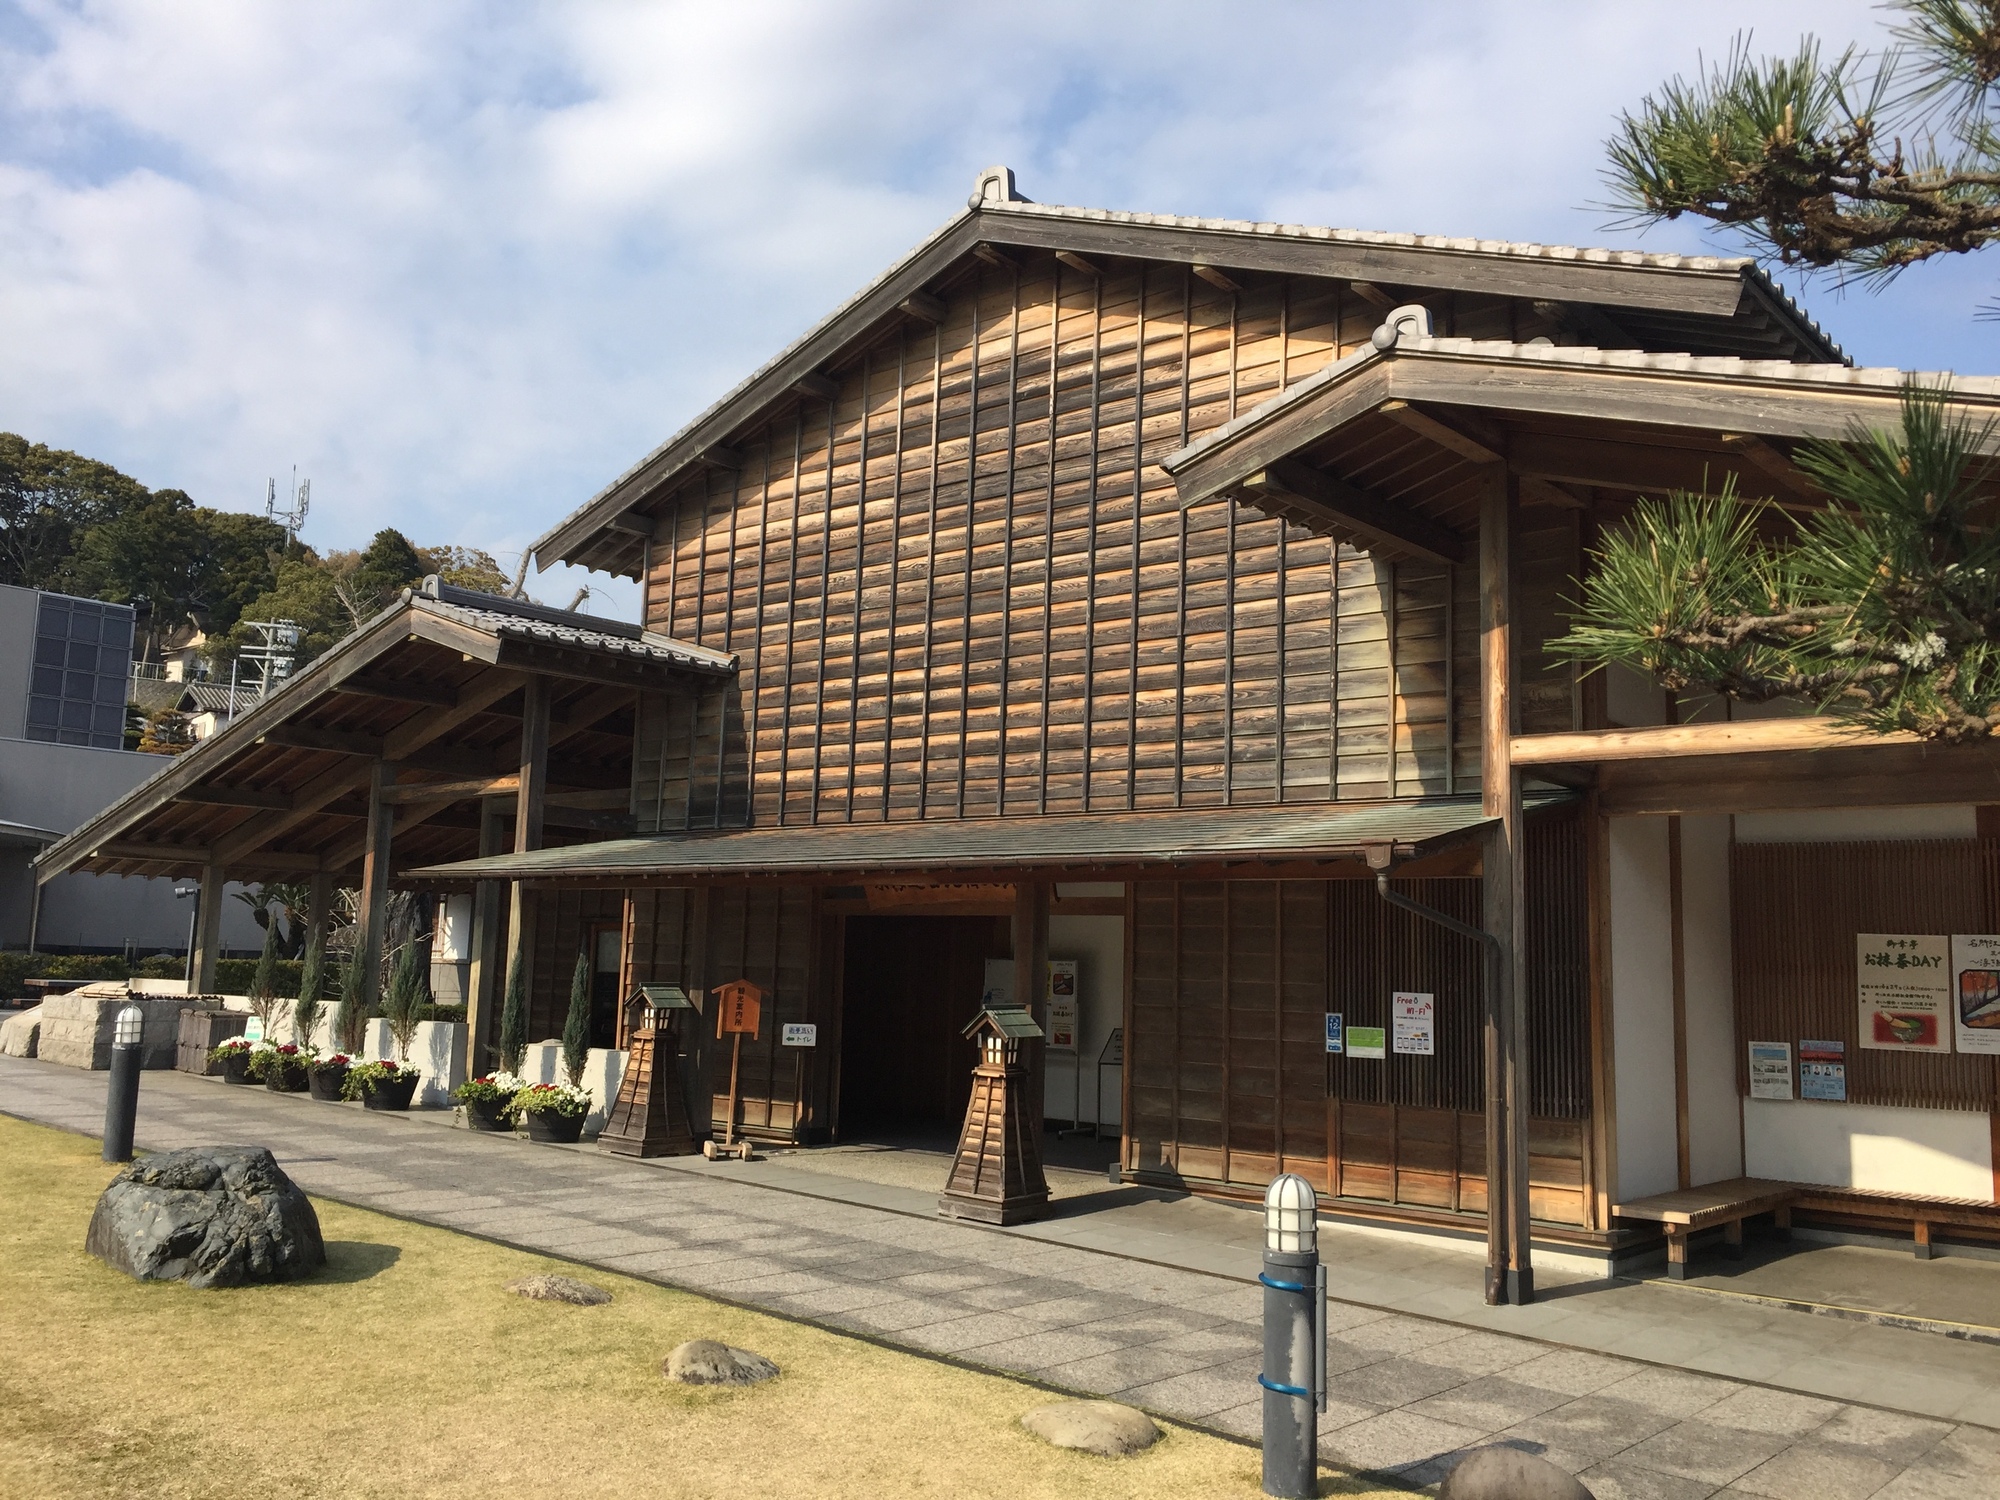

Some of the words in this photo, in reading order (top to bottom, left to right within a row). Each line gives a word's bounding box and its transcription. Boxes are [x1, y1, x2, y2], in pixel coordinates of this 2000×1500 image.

[735, 987, 745, 1026] 観光案内所
[1396, 996, 1412, 1004] Free
